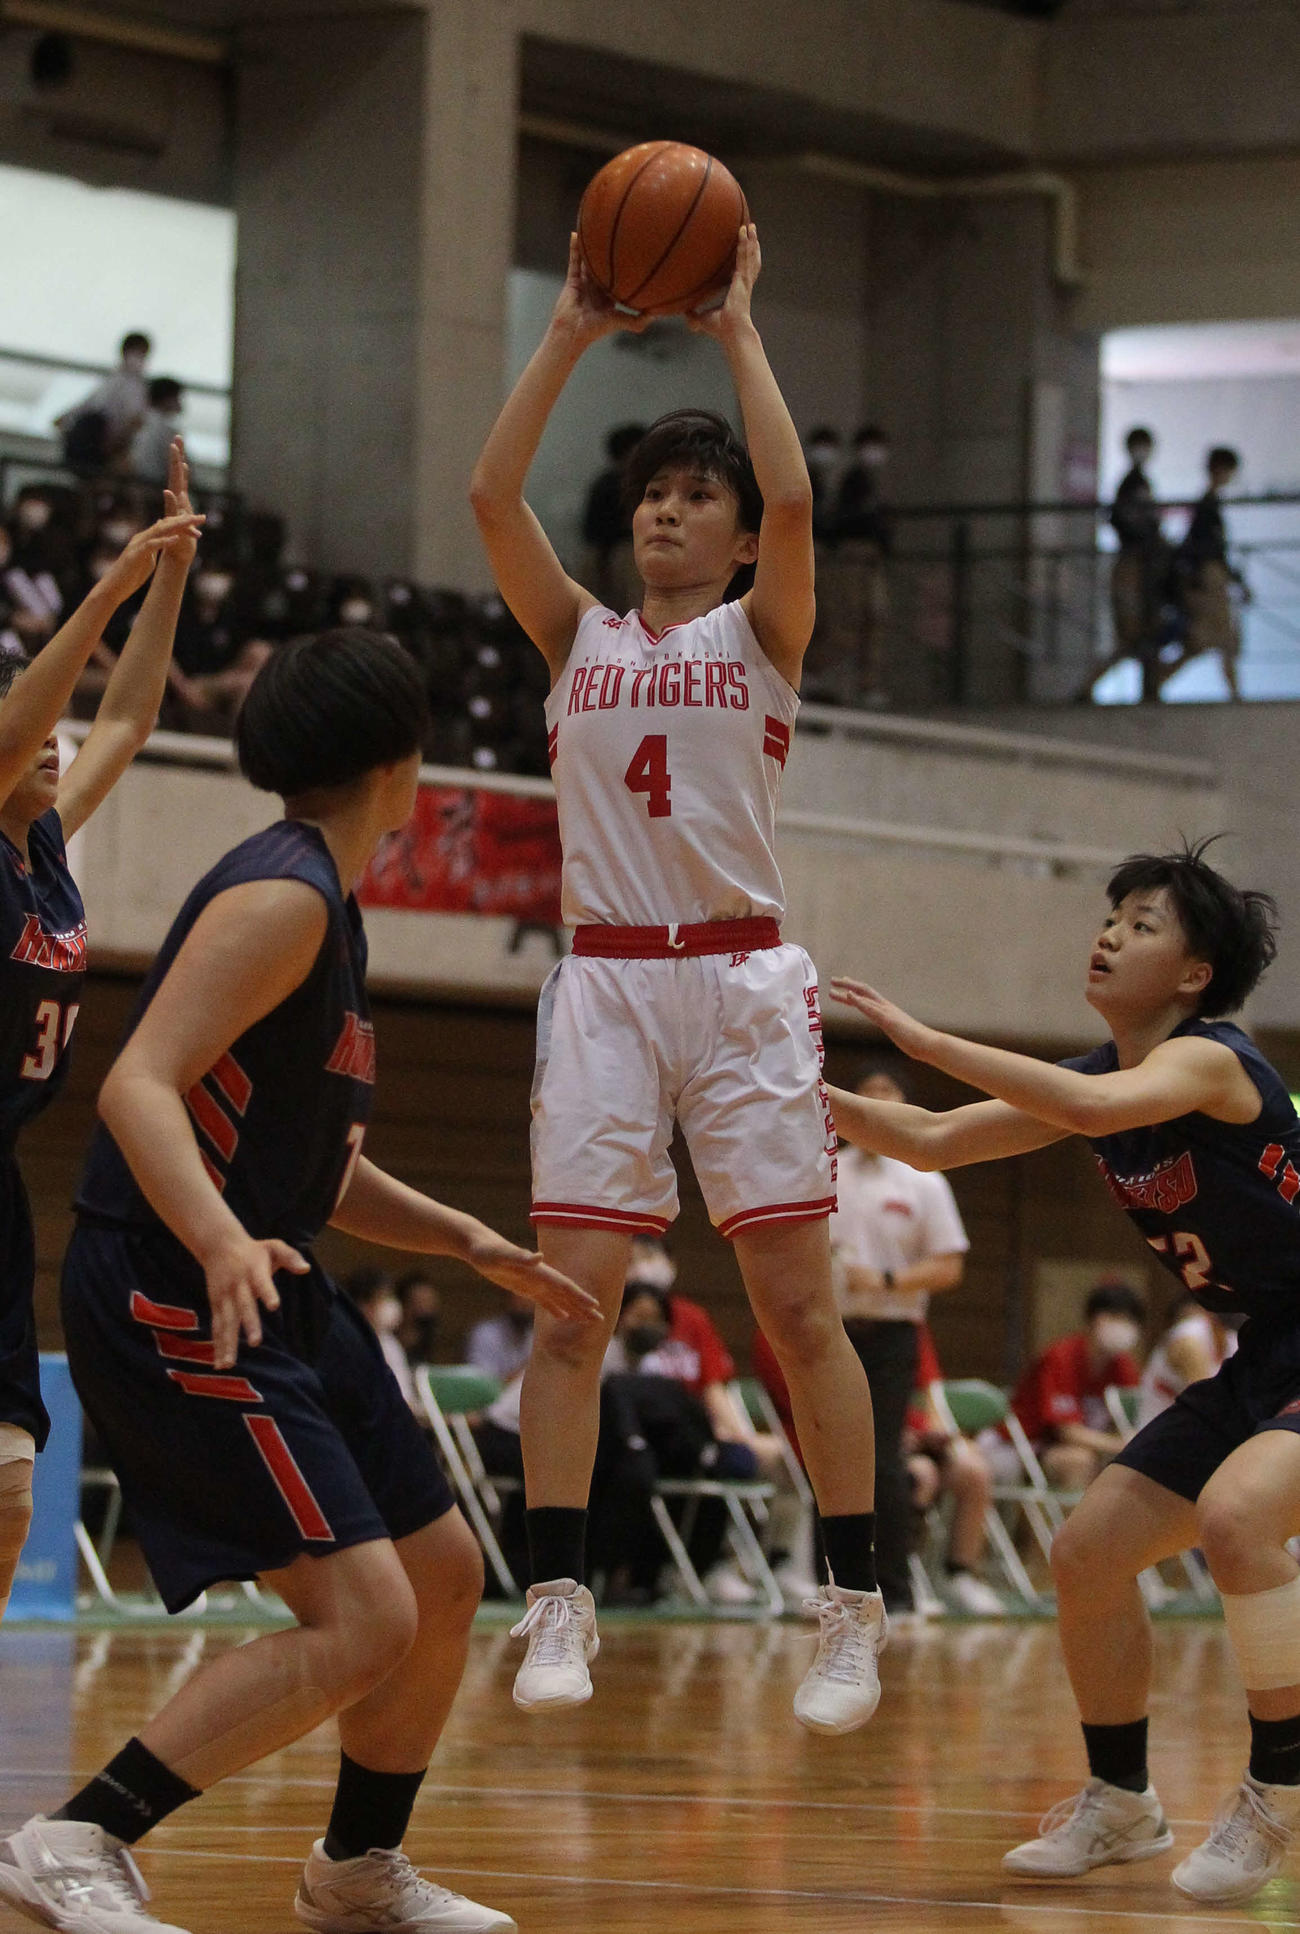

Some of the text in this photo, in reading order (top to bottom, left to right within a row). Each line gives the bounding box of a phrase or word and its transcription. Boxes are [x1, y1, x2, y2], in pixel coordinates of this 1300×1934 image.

[567, 660, 749, 716] RED TIGERS
[623, 734, 672, 818] 4
